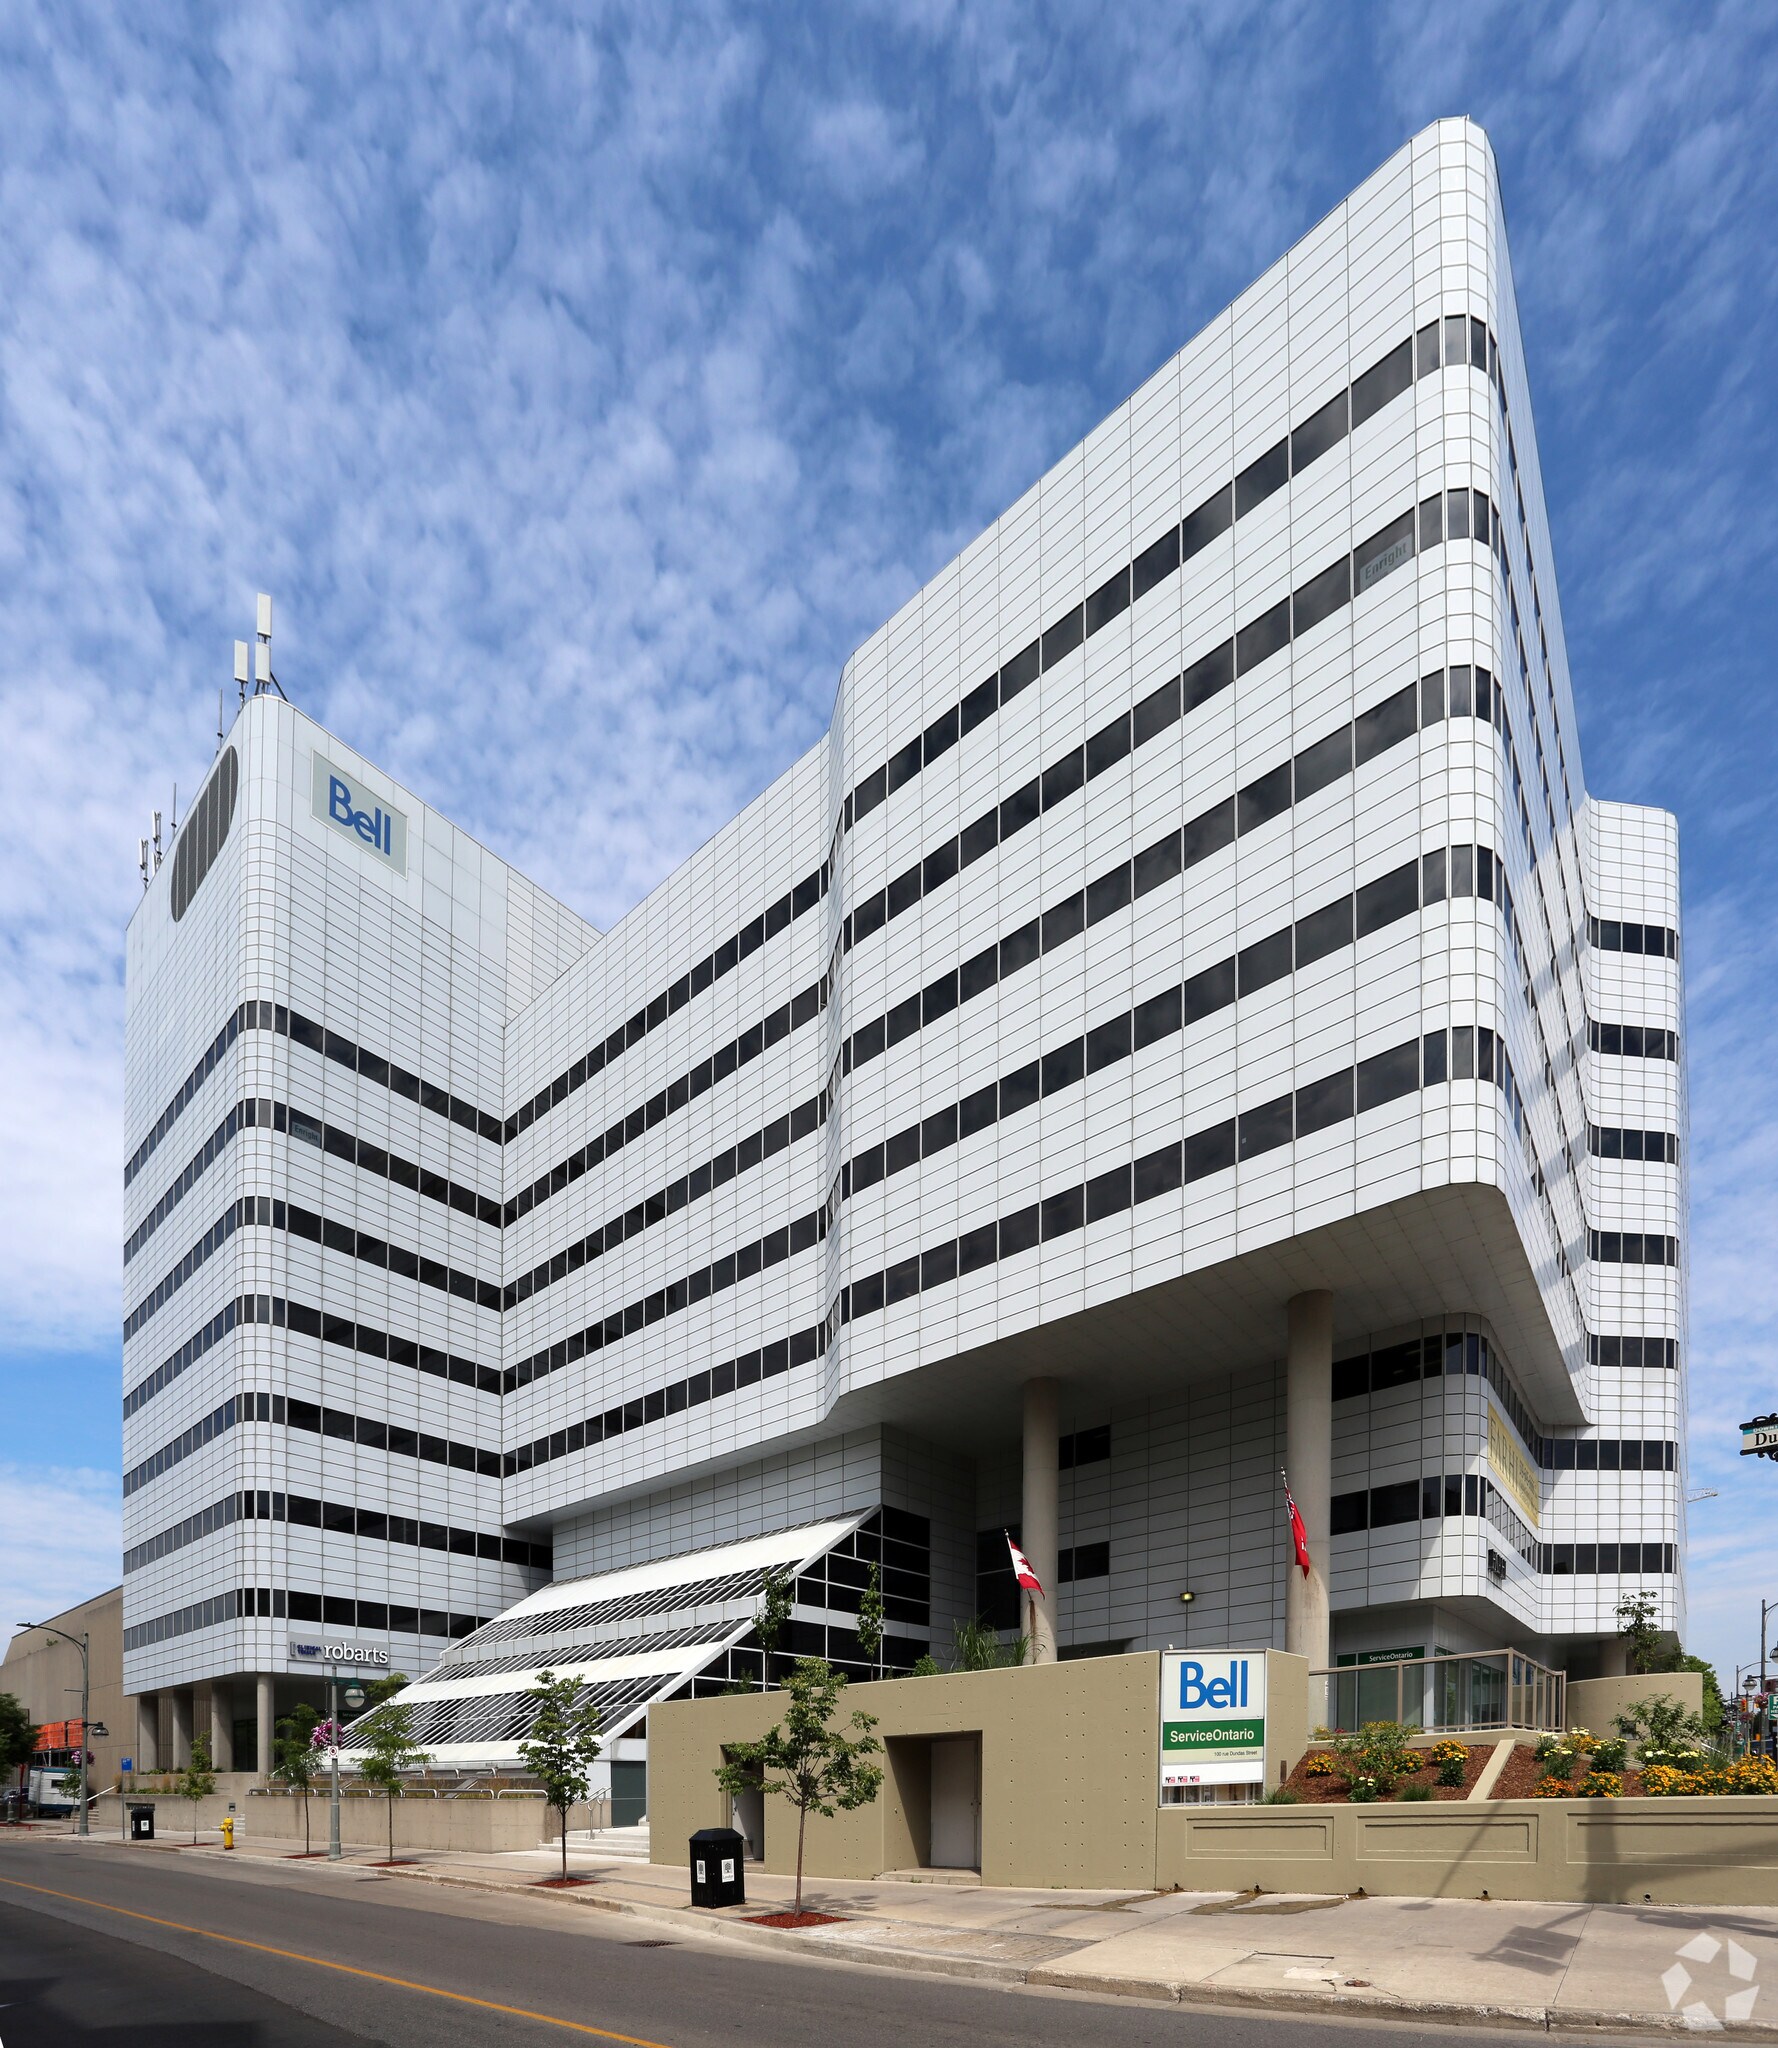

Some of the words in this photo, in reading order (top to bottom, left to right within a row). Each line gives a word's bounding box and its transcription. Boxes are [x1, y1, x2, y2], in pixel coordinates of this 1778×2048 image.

[1365, 542, 1406, 580] Enright
[329, 774, 391, 856] Bell
[324, 1642, 388, 1663] robarts
[1369, 1651, 1413, 1663] ServiceOntario
[1180, 1660, 1248, 1709] Bell
[1170, 1728, 1255, 1743] ServiceOntario
